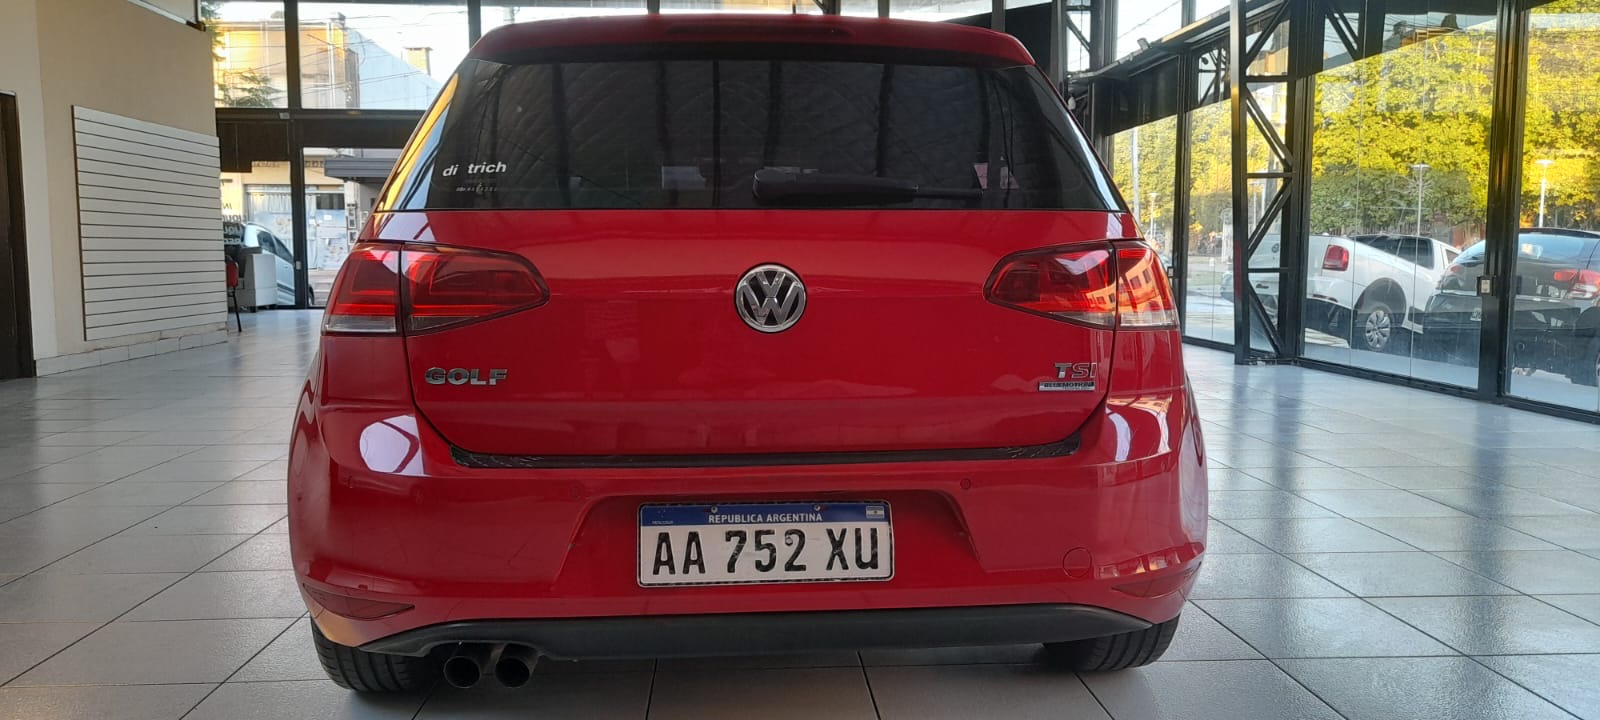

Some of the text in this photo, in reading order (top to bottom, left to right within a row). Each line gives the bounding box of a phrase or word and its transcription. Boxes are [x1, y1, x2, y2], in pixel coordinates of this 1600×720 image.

[425, 366, 508, 385] GOLF
[1055, 362, 1097, 379] TSI
[708, 512, 823, 524] REPUBLICA ARGENTINA
[652, 527, 879, 575] AA 752 XU
